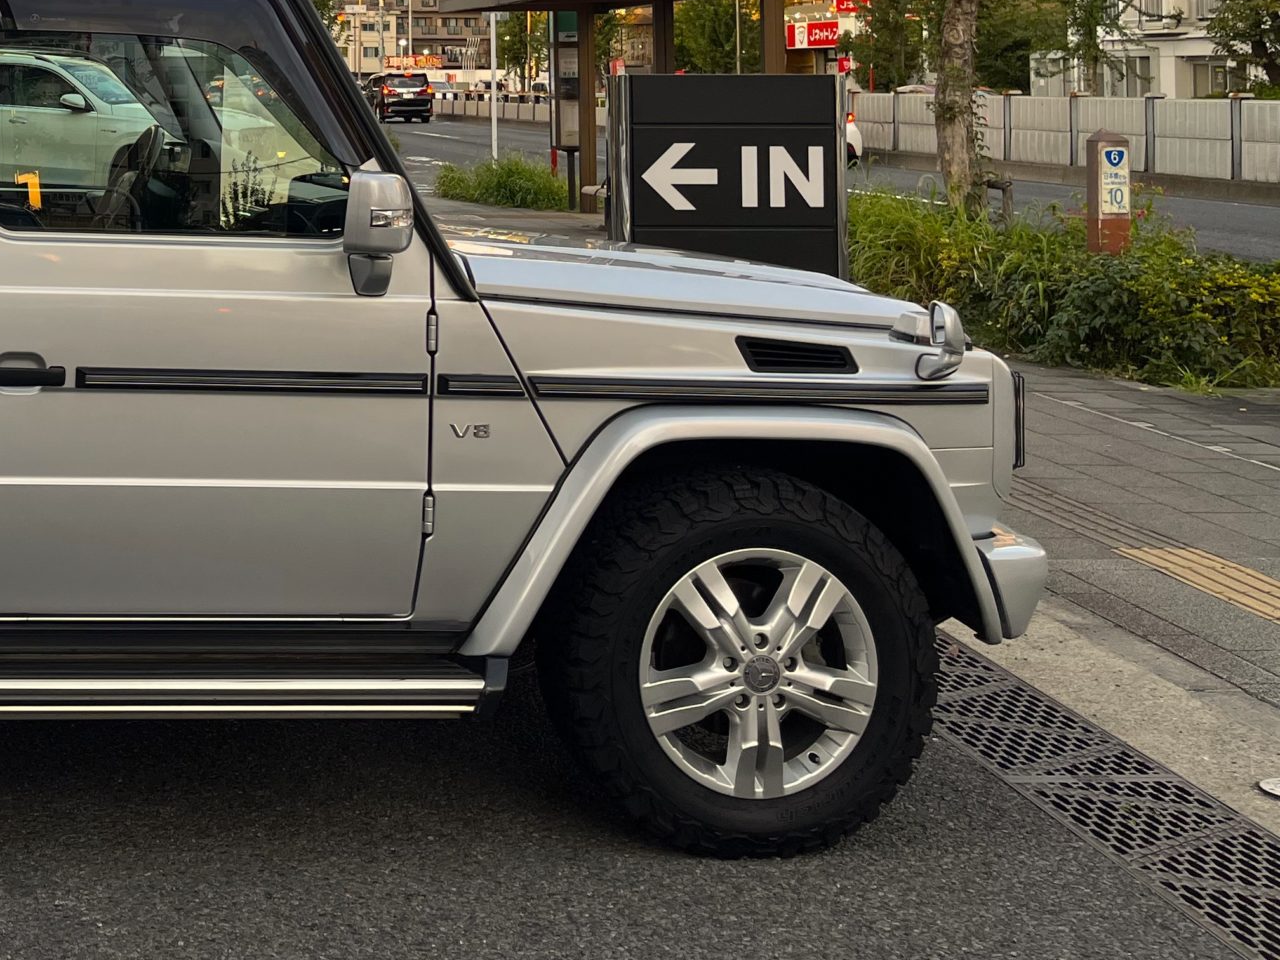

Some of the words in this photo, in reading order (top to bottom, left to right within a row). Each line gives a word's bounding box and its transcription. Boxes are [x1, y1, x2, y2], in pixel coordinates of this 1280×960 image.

[1111, 151, 1119, 163] 6
[741, 146, 824, 207] IN
[1107, 188, 1123, 206] 10
[449, 423, 490, 439] V8
